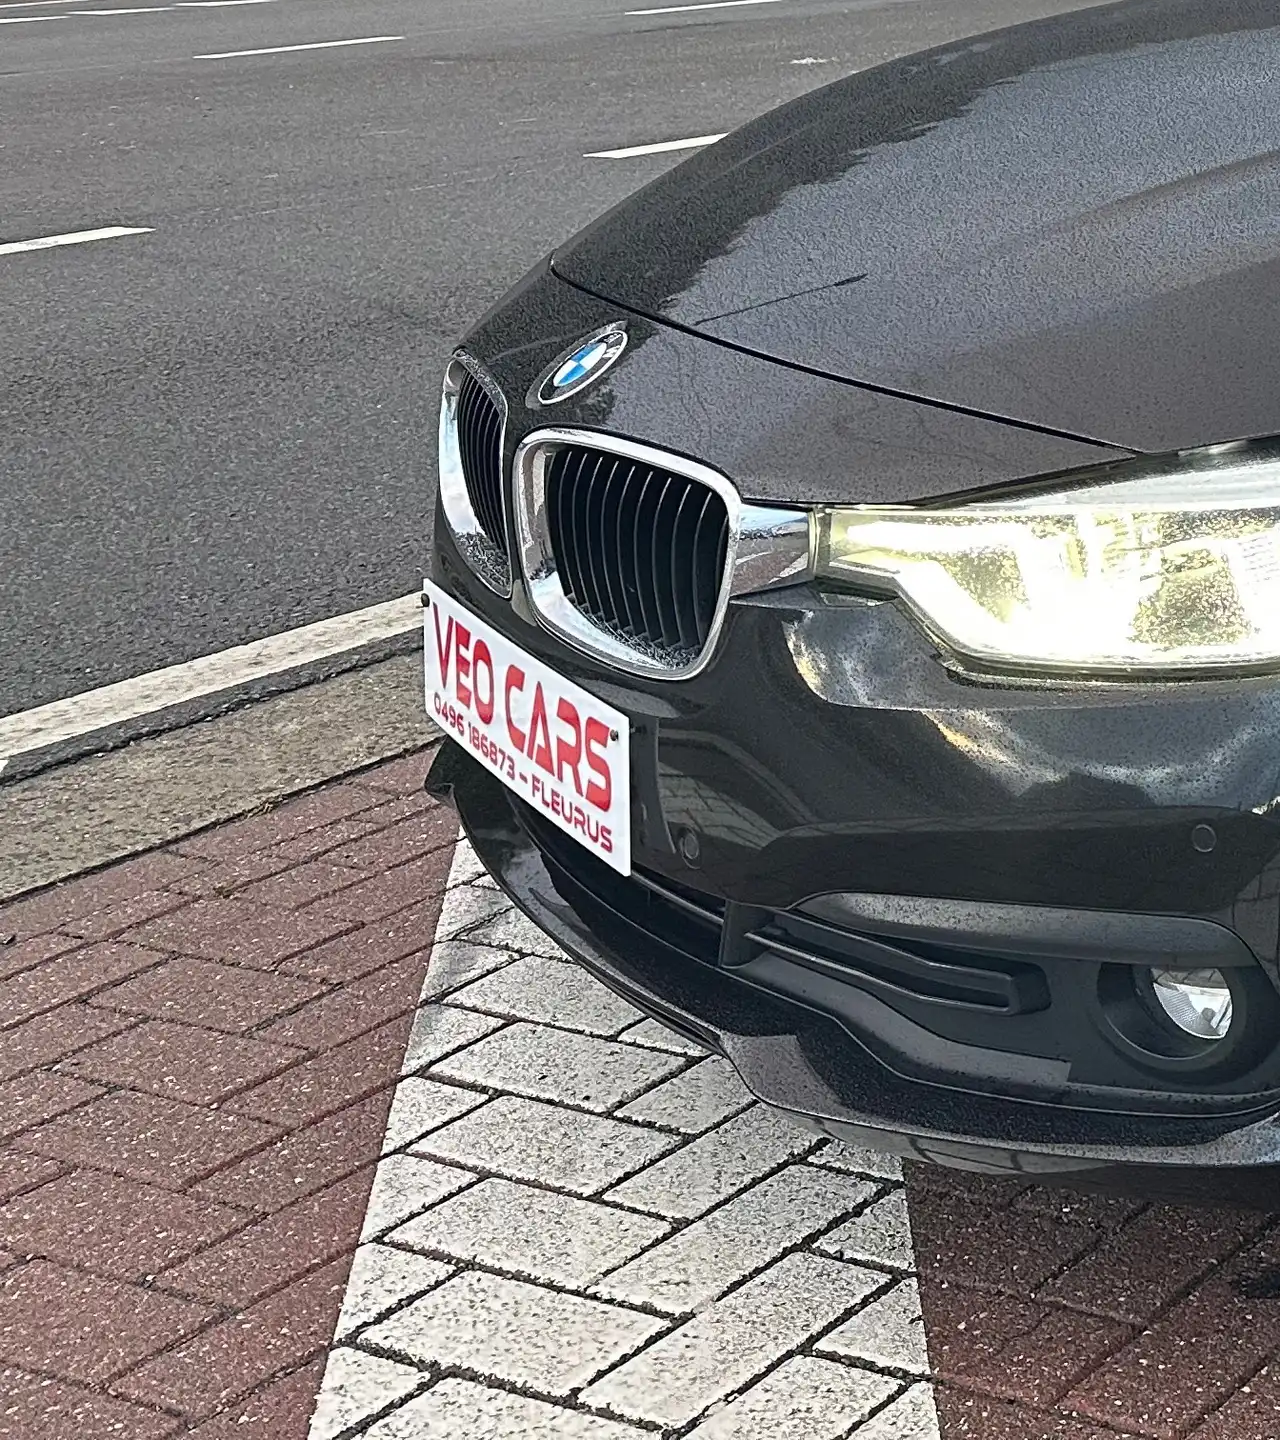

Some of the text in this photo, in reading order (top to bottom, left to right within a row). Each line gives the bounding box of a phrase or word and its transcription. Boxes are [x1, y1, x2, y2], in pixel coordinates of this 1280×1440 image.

[432, 602, 613, 813] VEO CARS
[433, 696, 466, 737] 0496
[467, 725, 516, 780] 186873
[531, 777, 613, 854] FLEURUS
